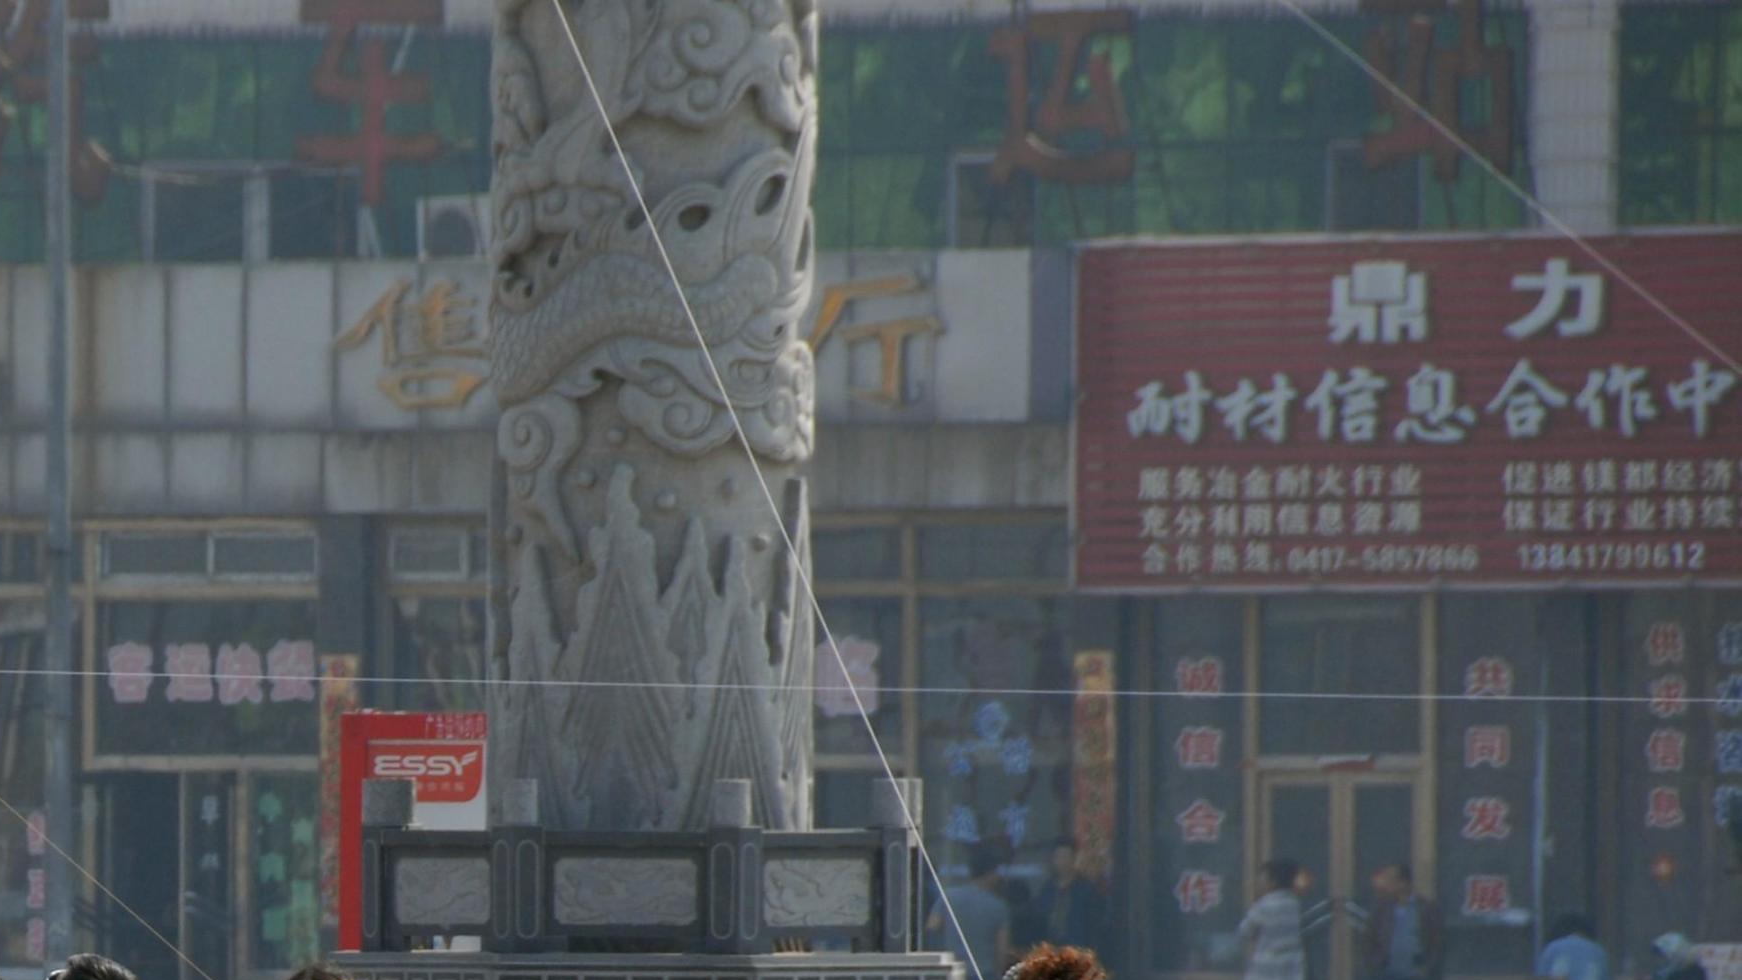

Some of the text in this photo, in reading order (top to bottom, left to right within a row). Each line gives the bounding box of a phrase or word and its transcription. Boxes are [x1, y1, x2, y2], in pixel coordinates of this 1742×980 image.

[1327, 258, 1608, 344] 鼎力
[1126, 357, 1740, 446] 耐材信息合作中
[1502, 458, 1742, 494] 促进镁都经济
[1502, 497, 1742, 532] 保证行业持续
